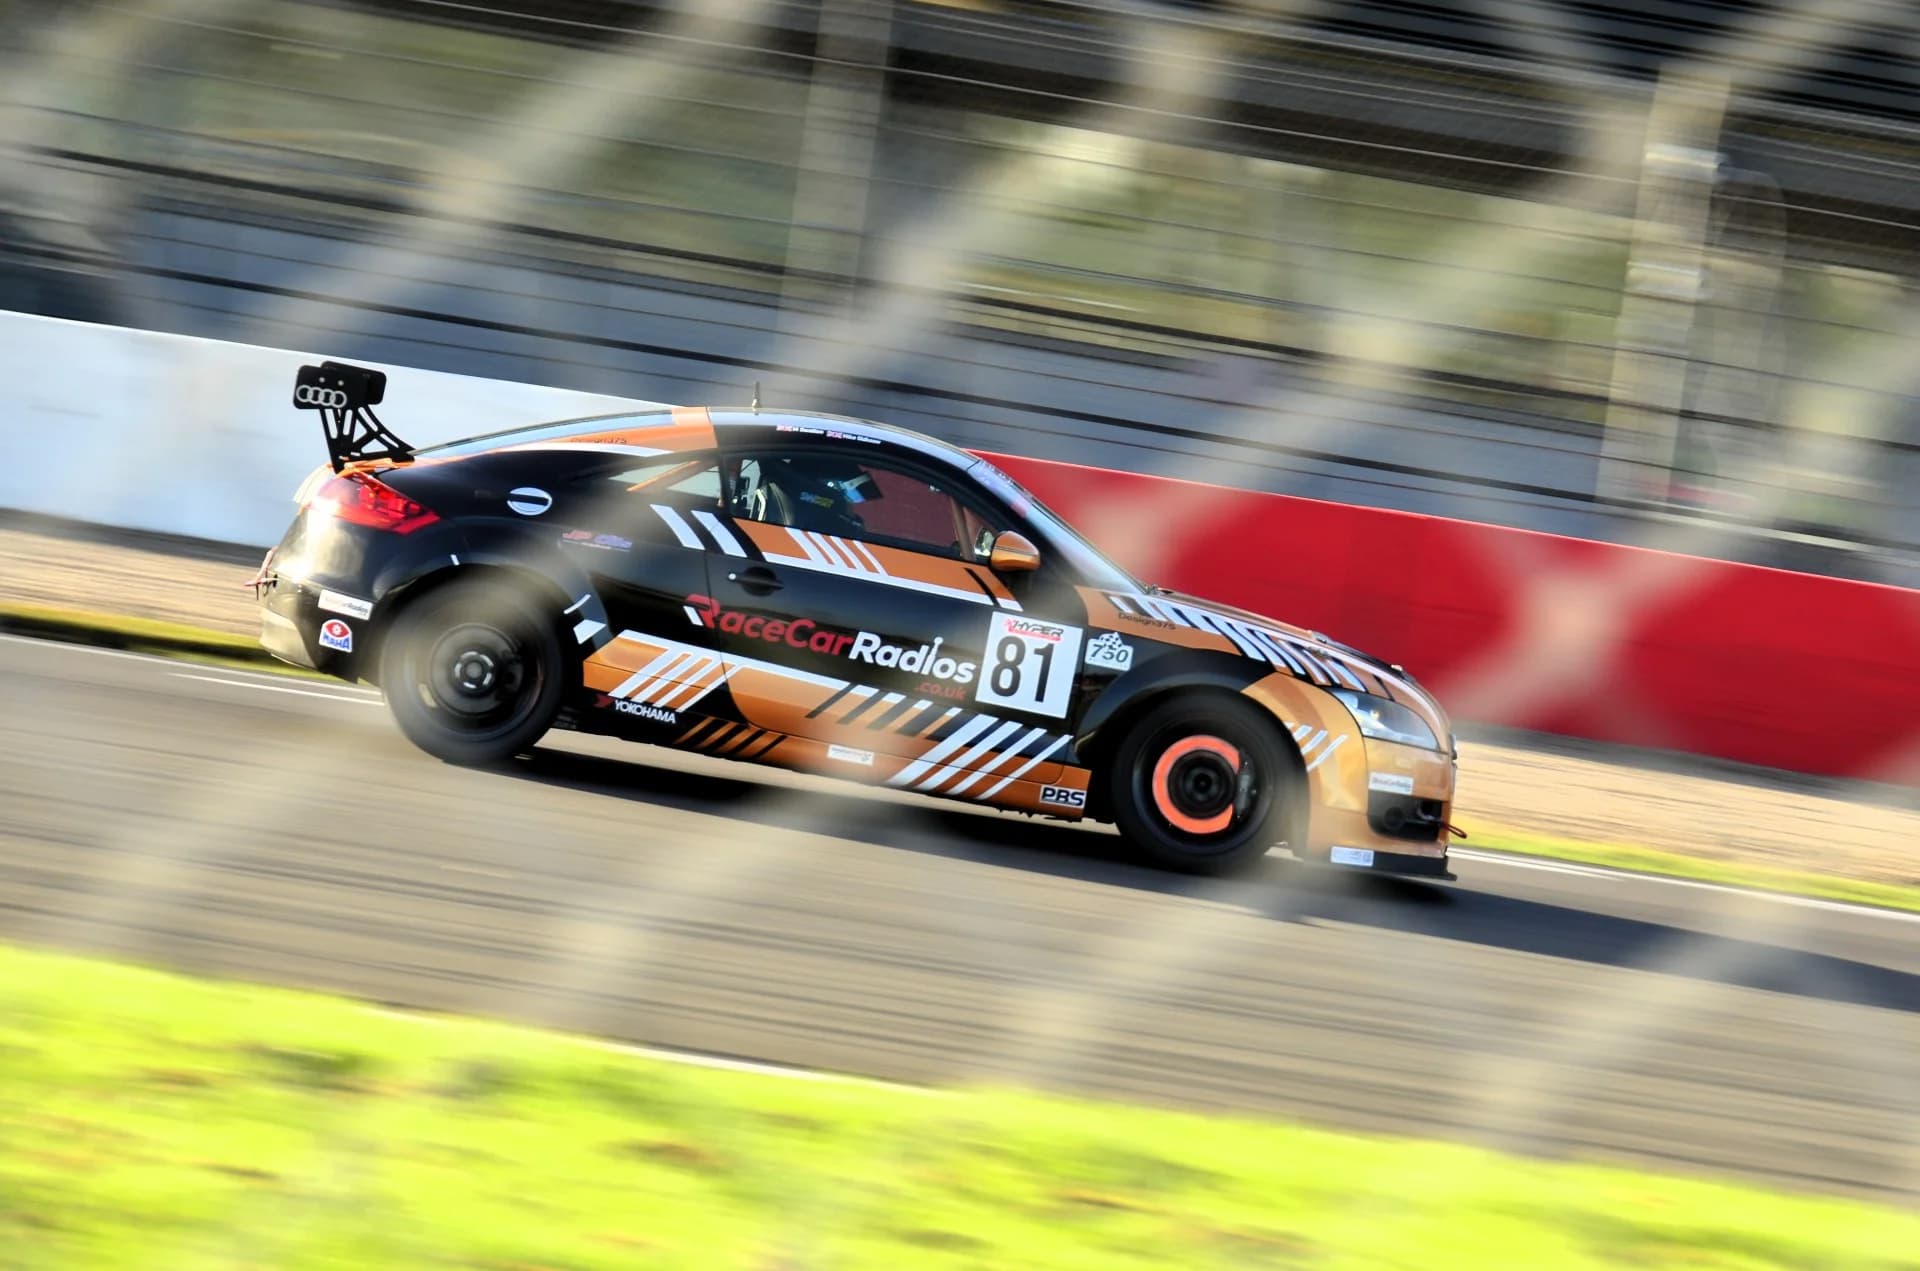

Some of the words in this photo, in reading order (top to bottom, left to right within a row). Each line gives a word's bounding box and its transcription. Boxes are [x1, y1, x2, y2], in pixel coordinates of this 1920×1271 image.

[685, 593, 977, 684] RaceCarRadios
[1011, 619, 1064, 638] HYPER
[1091, 643, 1130, 663] 750
[990, 635, 1055, 703] 81
[914, 680, 967, 701] .co.uk
[614, 699, 677, 724] YOKOHAMA
[1041, 786, 1086, 807] PRS
